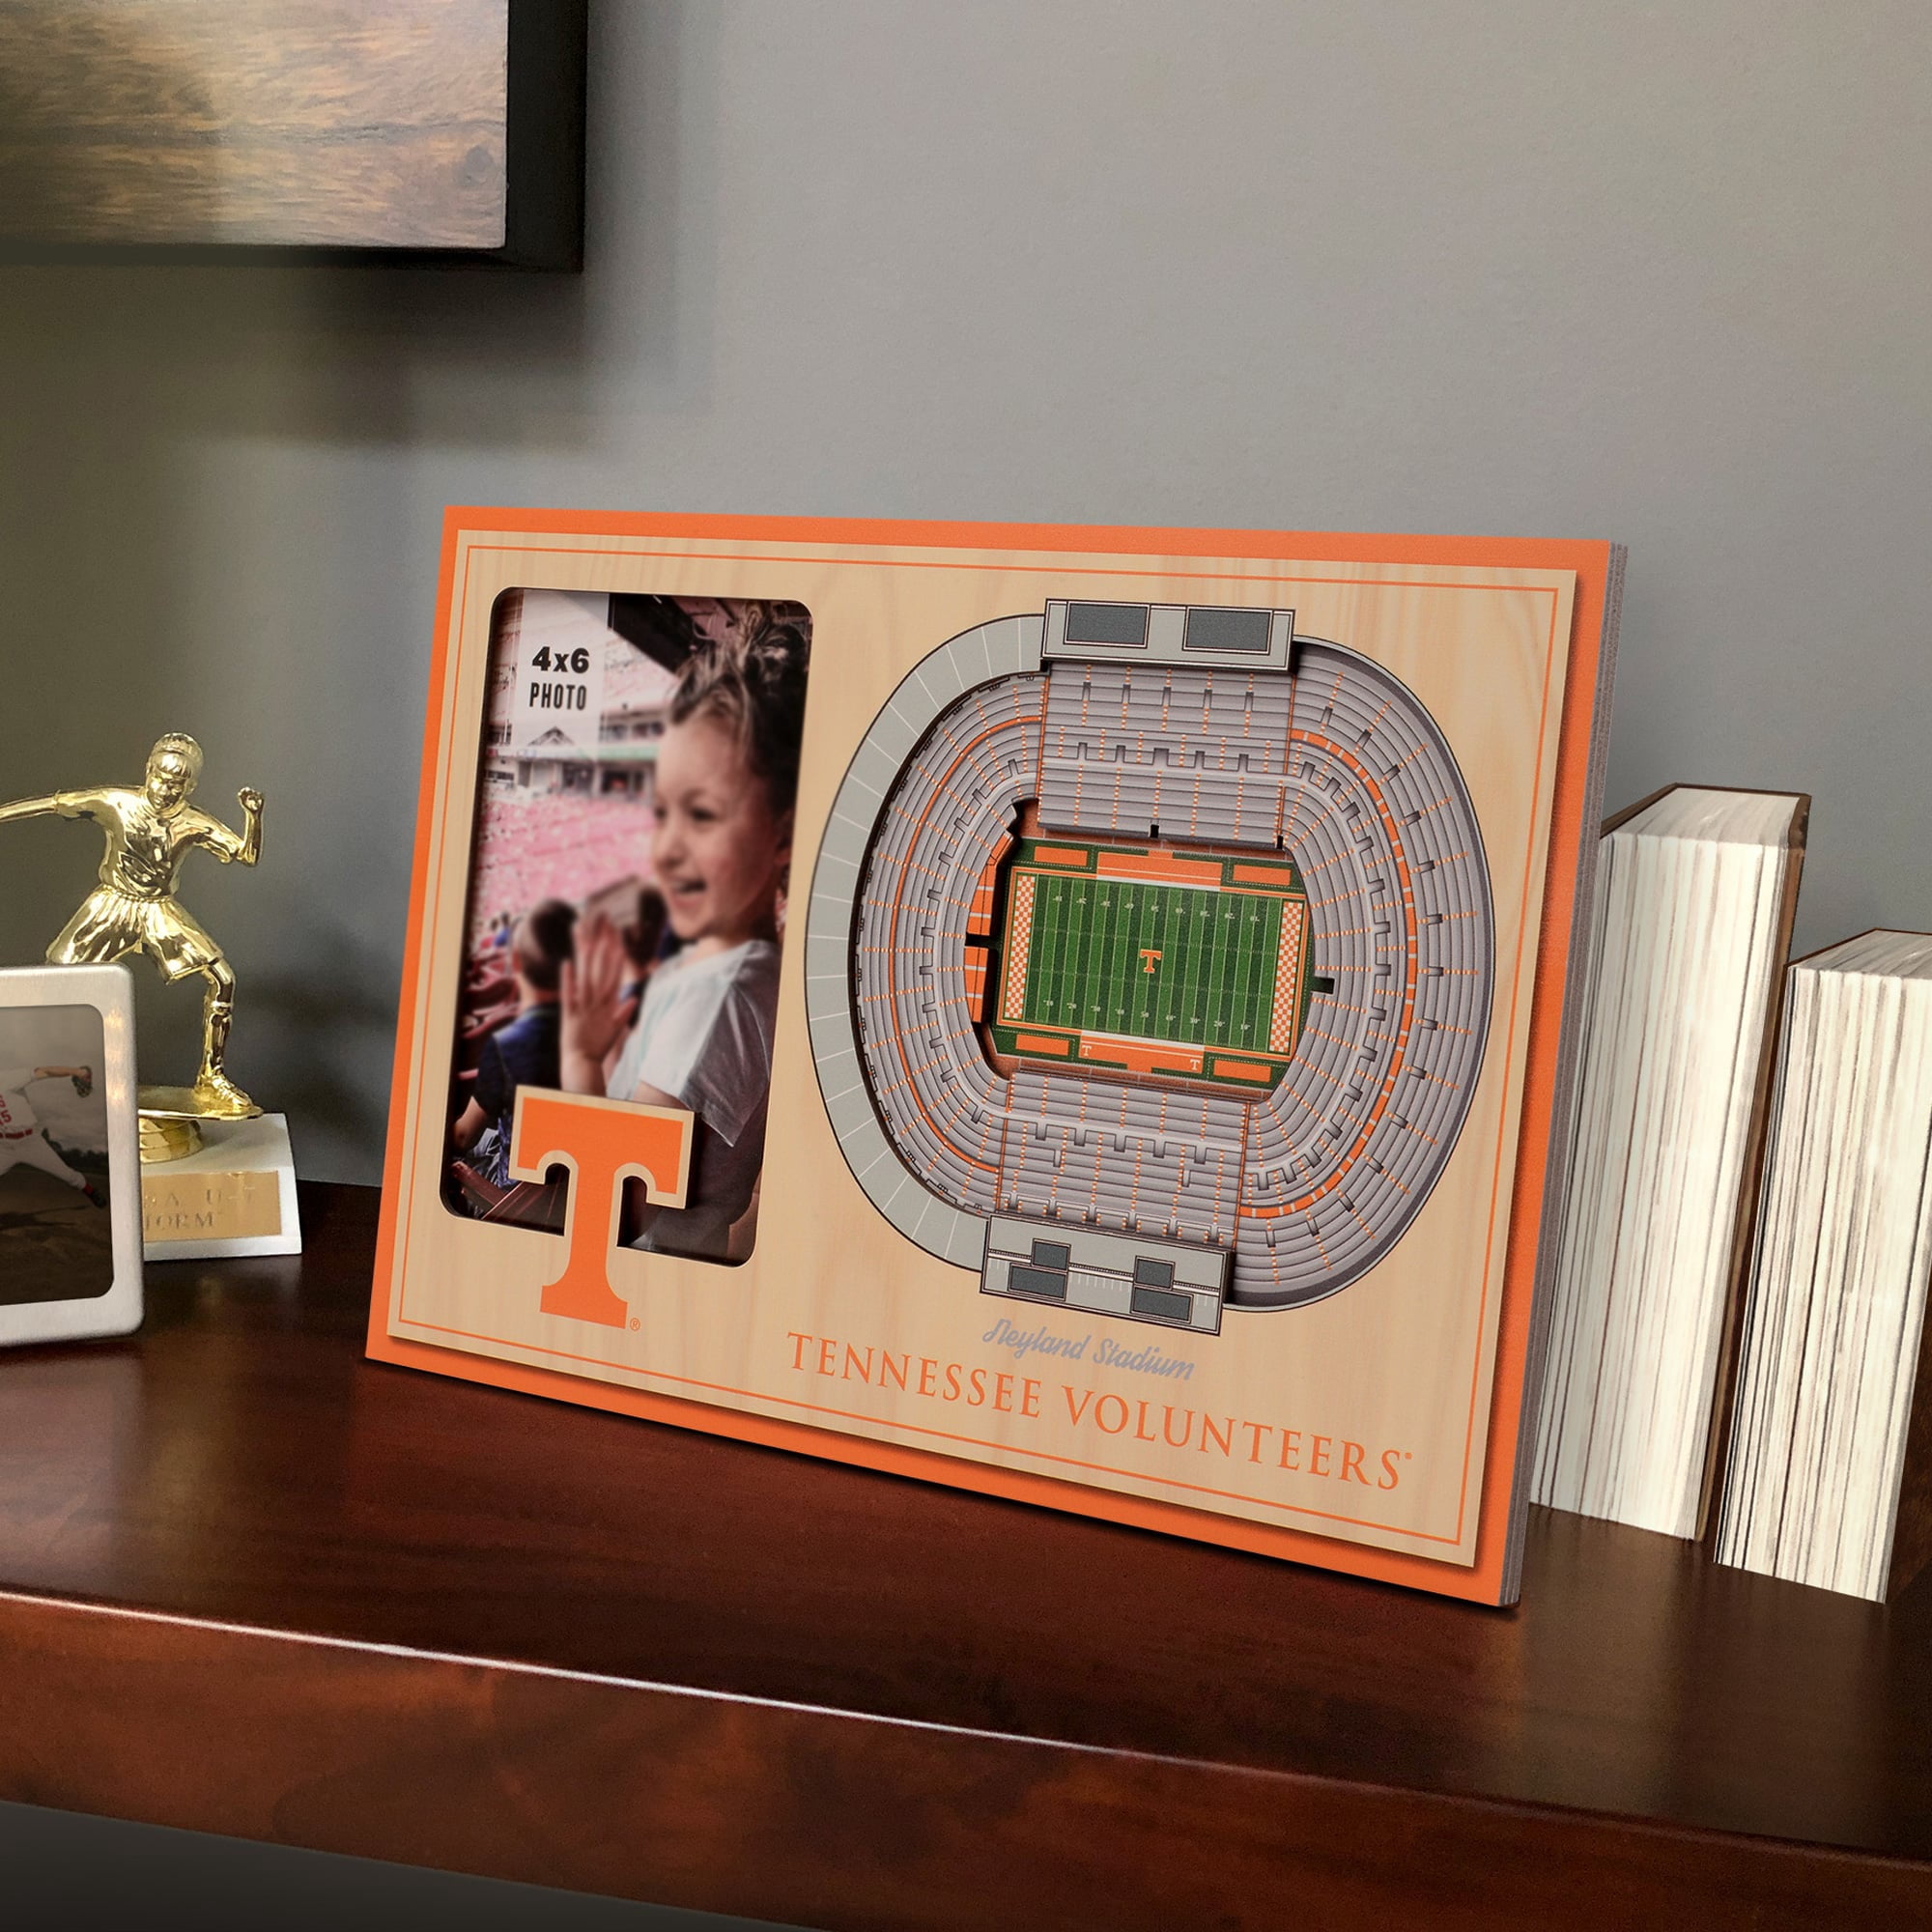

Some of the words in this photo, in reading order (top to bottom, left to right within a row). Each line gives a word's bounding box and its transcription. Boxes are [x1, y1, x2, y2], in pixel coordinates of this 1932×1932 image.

[531, 646, 590, 674] 4x6
[529, 682, 587, 711] PHOTO
[981, 1318, 1093, 1359] Neyland
[1093, 1338, 1195, 1380] Stadium
[786, 1330, 1042, 1419] TENNESSEE
[1061, 1384, 1401, 1491] VOLUNTEERS
